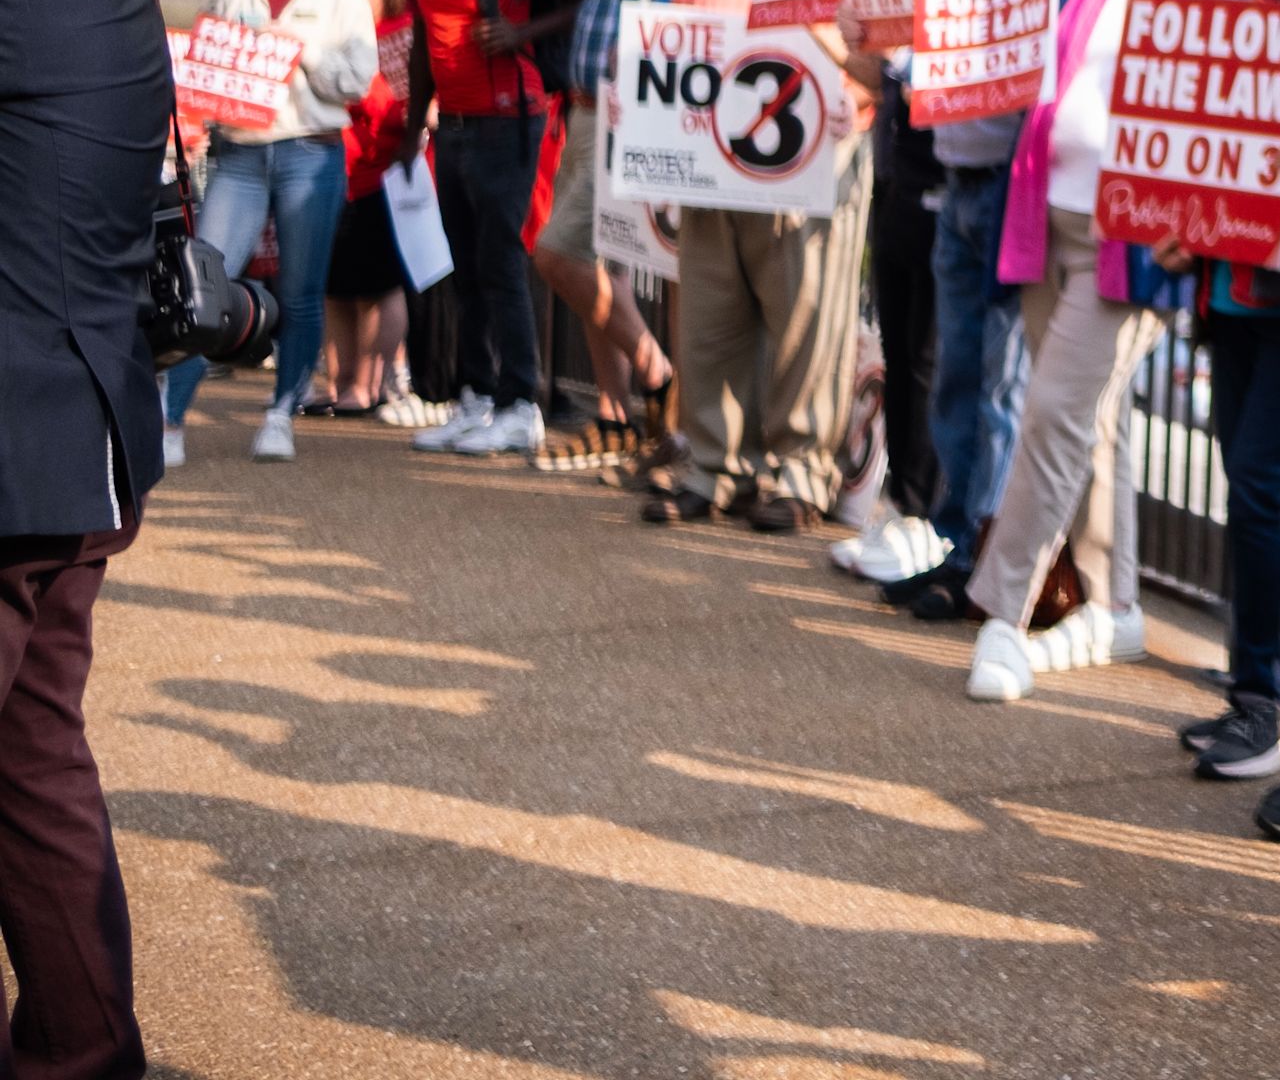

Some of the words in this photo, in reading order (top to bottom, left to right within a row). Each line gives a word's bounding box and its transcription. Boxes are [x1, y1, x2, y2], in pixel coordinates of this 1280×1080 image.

[638, 18, 723, 61] VOTE
[924, 13, 990, 50] THE
[992, 1, 1048, 41] LAW
[637, 58, 722, 107] NO
[929, 56, 971, 81] NO
[985, 47, 1020, 74] ON
[1122, 54, 1200, 112] THE
[729, 60, 805, 167] 3
[1115, 125, 1169, 169] NO
[1186, 137, 1242, 181] ON
[1258, 147, 1279, 186] 3
[1102, 179, 1184, 232] Protect
